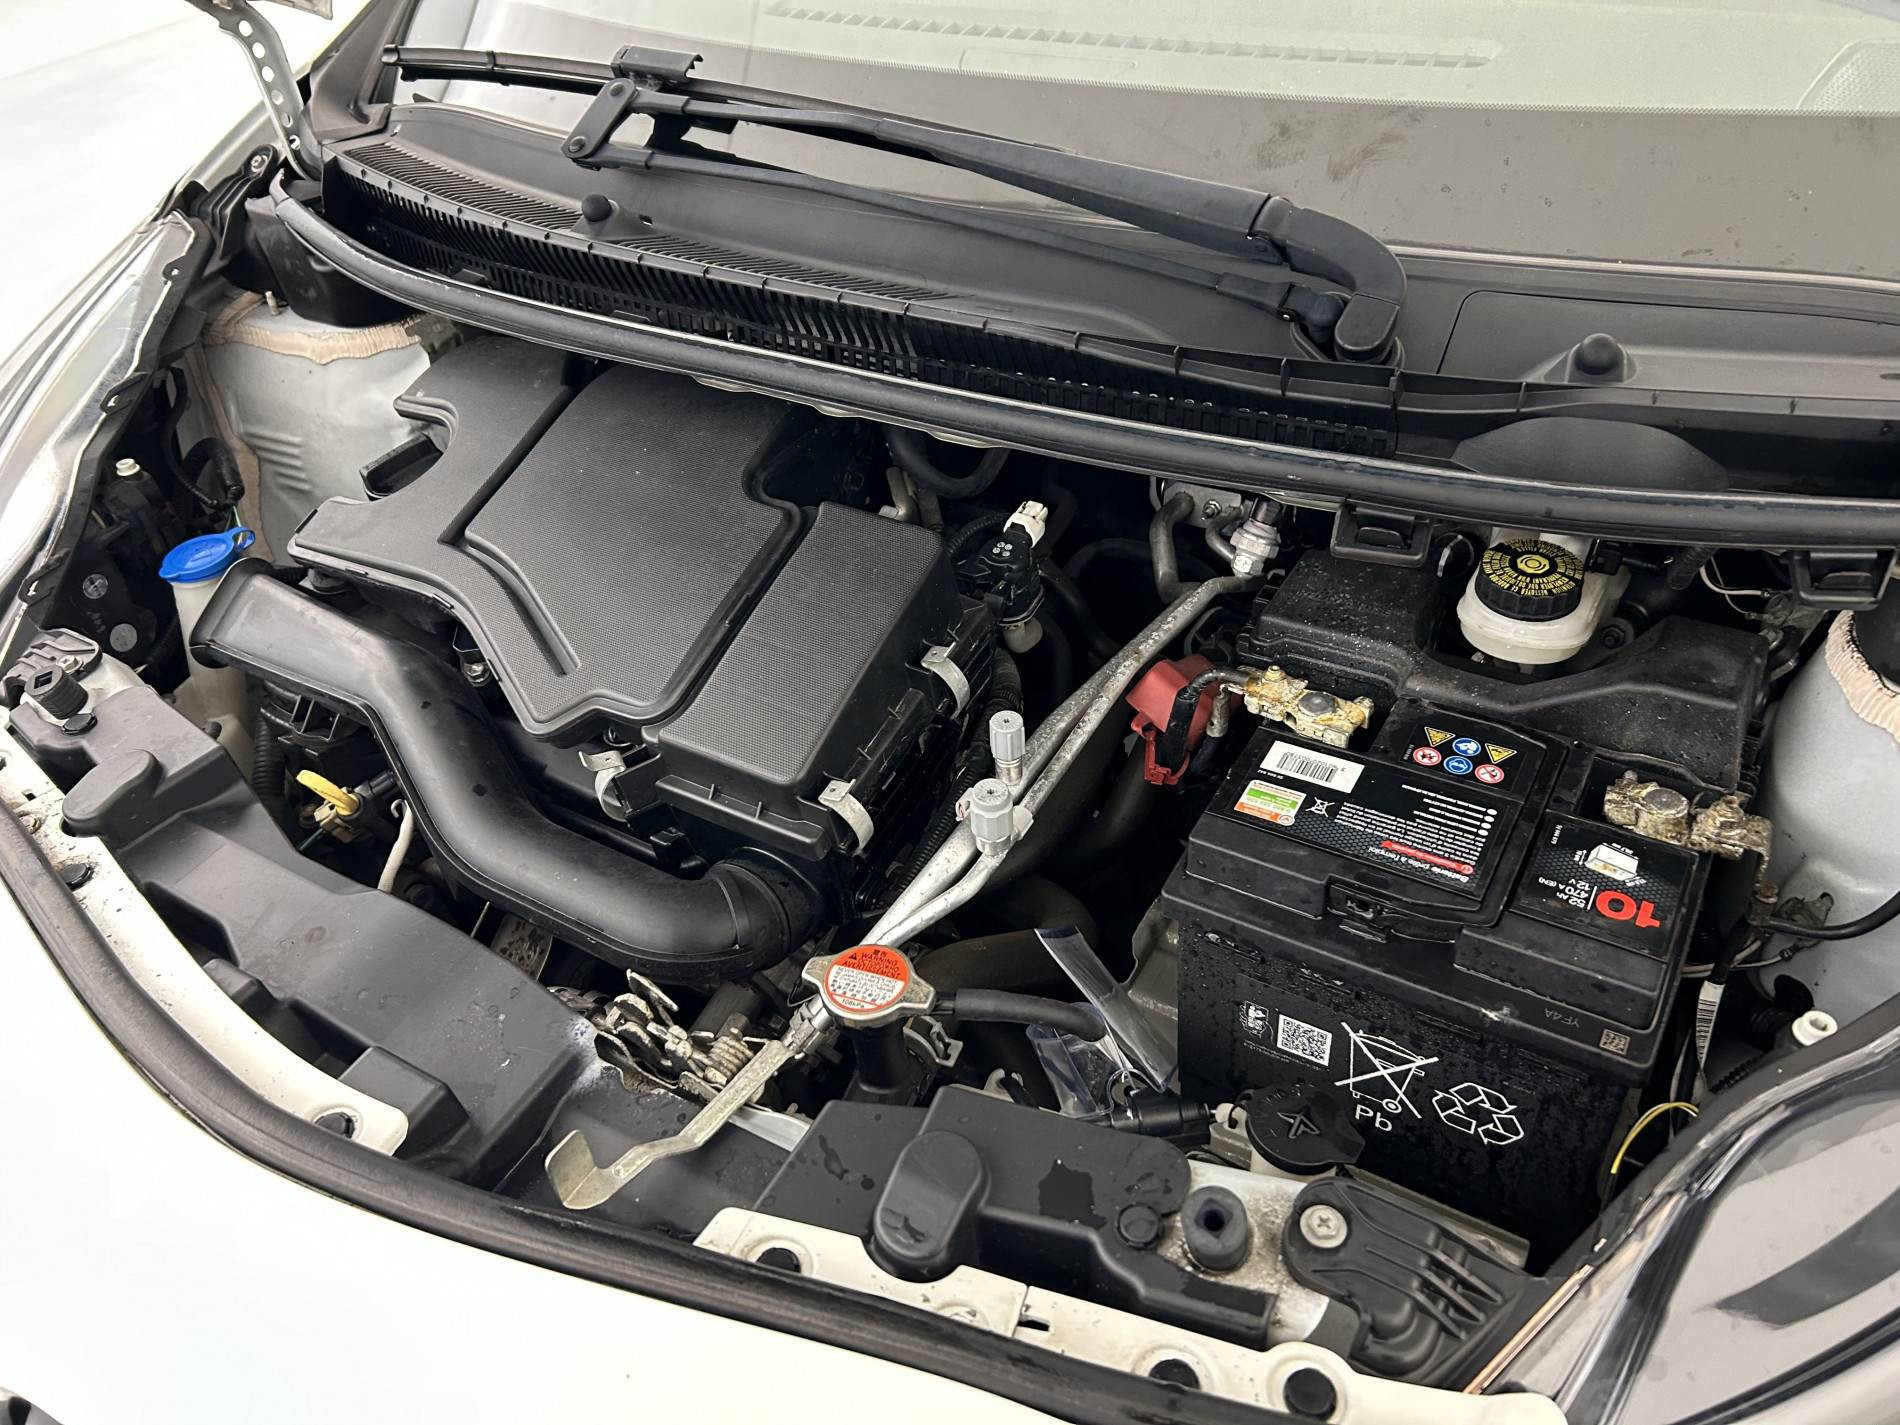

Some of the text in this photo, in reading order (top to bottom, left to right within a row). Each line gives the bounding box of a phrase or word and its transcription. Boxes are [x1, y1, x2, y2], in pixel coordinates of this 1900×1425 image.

[1565, 885, 1588, 898] 470
[1577, 880, 1591, 891] 12
[1556, 892, 1586, 908] 52 Ah
[1595, 890, 1661, 928] 10
[1354, 1104, 1394, 1132] Pb
